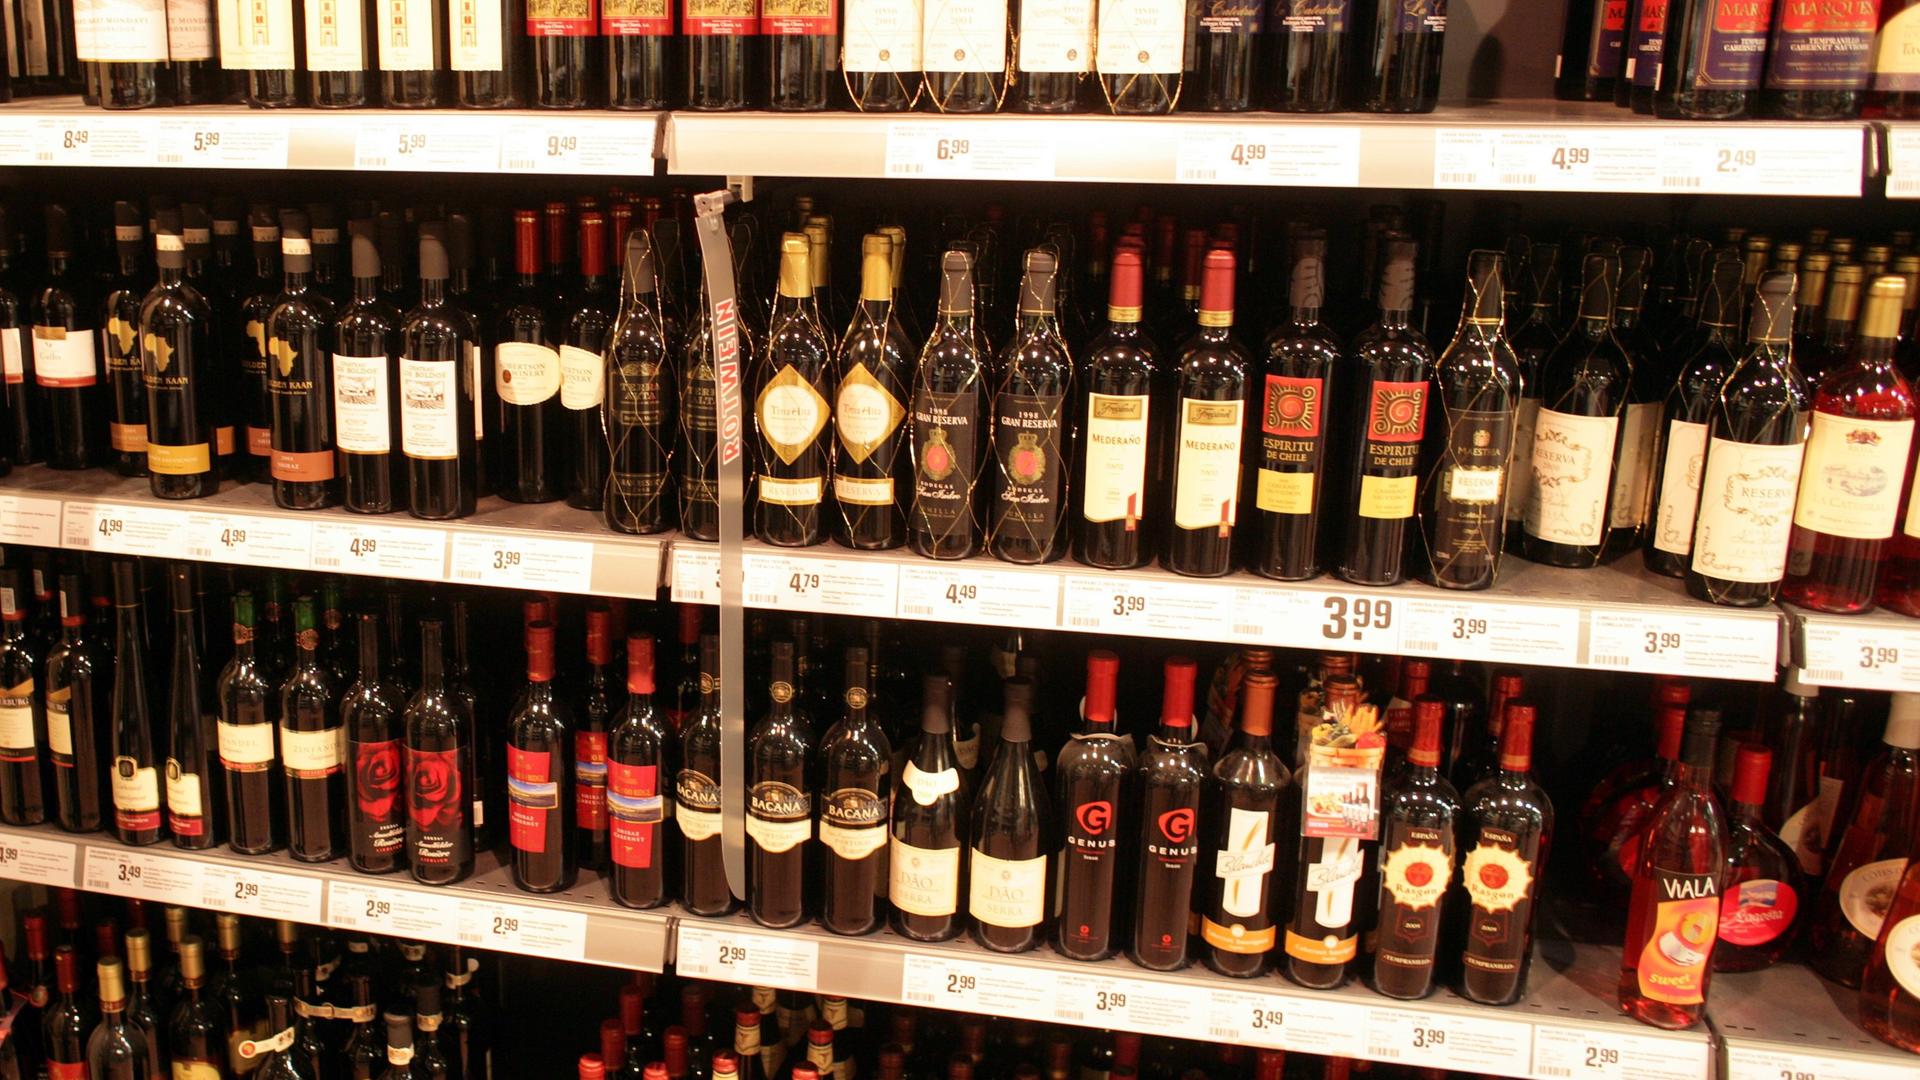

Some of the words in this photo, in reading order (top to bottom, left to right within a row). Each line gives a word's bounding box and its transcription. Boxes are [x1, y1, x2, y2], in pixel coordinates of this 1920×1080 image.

[63, 130, 89, 149] 8.49
[193, 131, 220, 152] 5.99
[397, 134, 427, 155] 5.99
[547, 135, 576, 157] 9.49
[937, 139, 970, 161] 6.99
[1231, 144, 1267, 166] 4.99
[1551, 147, 1590, 171] 4.99
[1716, 149, 1757, 173] 2.49
[715, 297, 741, 466] ROTWEIN
[934, 415, 969, 426] RESERVA
[1002, 415, 1021, 427] GRAN
[1018, 411, 1039, 421] 1998
[1263, 436, 1315, 453] ESPIRITU
[1370, 444, 1420, 457] ESPIRITU
[1266, 451, 1283, 460] DE
[1284, 453, 1309, 463] CHILE
[1374, 456, 1388, 466] DE
[1389, 457, 1415, 467] CHILE
[98, 518, 123, 537] 4.99
[220, 528, 246, 547] 4.99
[350, 538, 377, 557] 4.99
[493, 550, 521, 570] 3.99
[789, 573, 820, 593] 4.79
[945, 583, 977, 605] 4.49
[1113, 594, 1145, 616] 3.99
[1321, 596, 1393, 641] 3.99
[1452, 617, 1487, 639] 3.99
[1643, 632, 1681, 654] 3.99
[1859, 646, 1898, 669] 3.99
[752, 796, 802, 813] BACANA
[828, 805, 880, 820] BACANA
[1067, 835, 1117, 849] GENUS
[1148, 844, 1198, 857] GENUS
[117, 862, 141, 883] 3.49
[234, 880, 259, 900] 2.99
[1661, 876, 1717, 900] VIALA
[366, 899, 390, 918] 2.99
[493, 916, 518, 936] 2.99
[719, 945, 746, 966] 2.99
[947, 973, 976, 995] 2.99
[1095, 990, 1127, 1013] 3.99
[1252, 1007, 1284, 1031] 3.49
[1412, 1026, 1446, 1050] 3.99
[1584, 1046, 1619, 1069] 2.99
